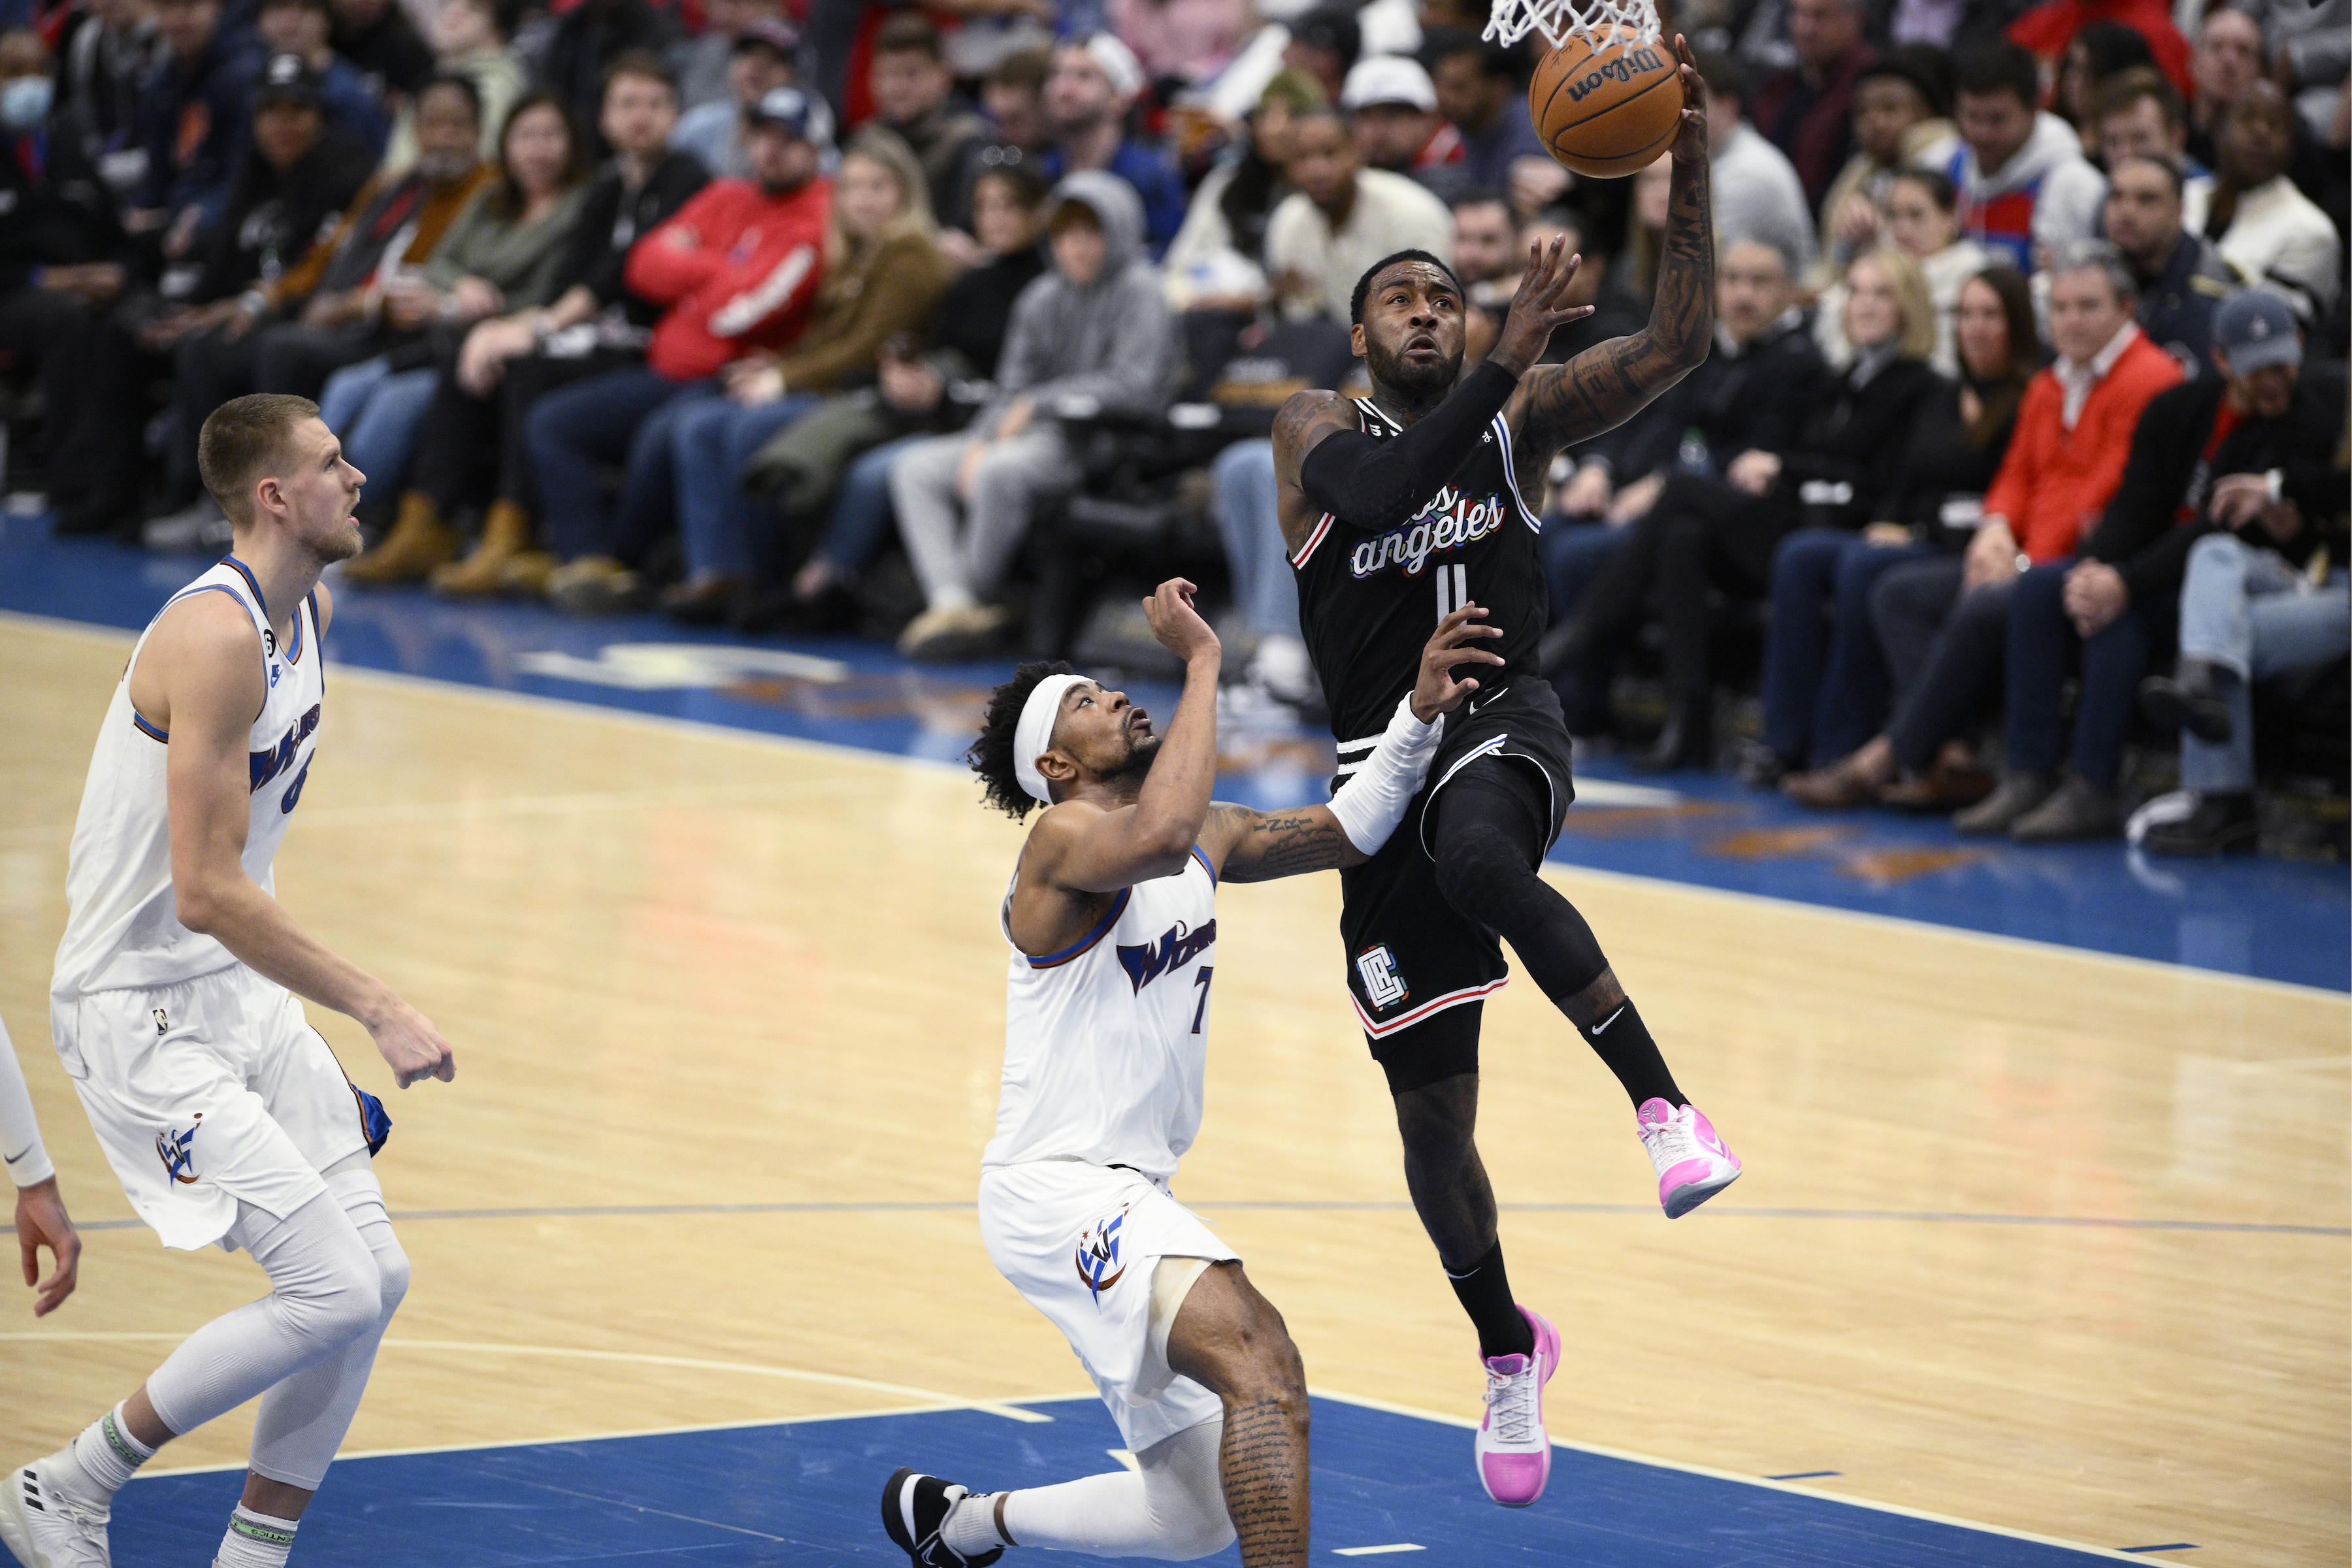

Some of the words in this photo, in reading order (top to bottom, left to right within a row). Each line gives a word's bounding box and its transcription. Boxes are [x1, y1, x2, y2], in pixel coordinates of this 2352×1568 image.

[1565, 46, 1665, 102] Wilson
[1351, 497, 1505, 575] angeles
[1437, 564, 1467, 626] 11
[1253, 817, 1313, 834] INRI
[1191, 966, 1214, 1034] 7
